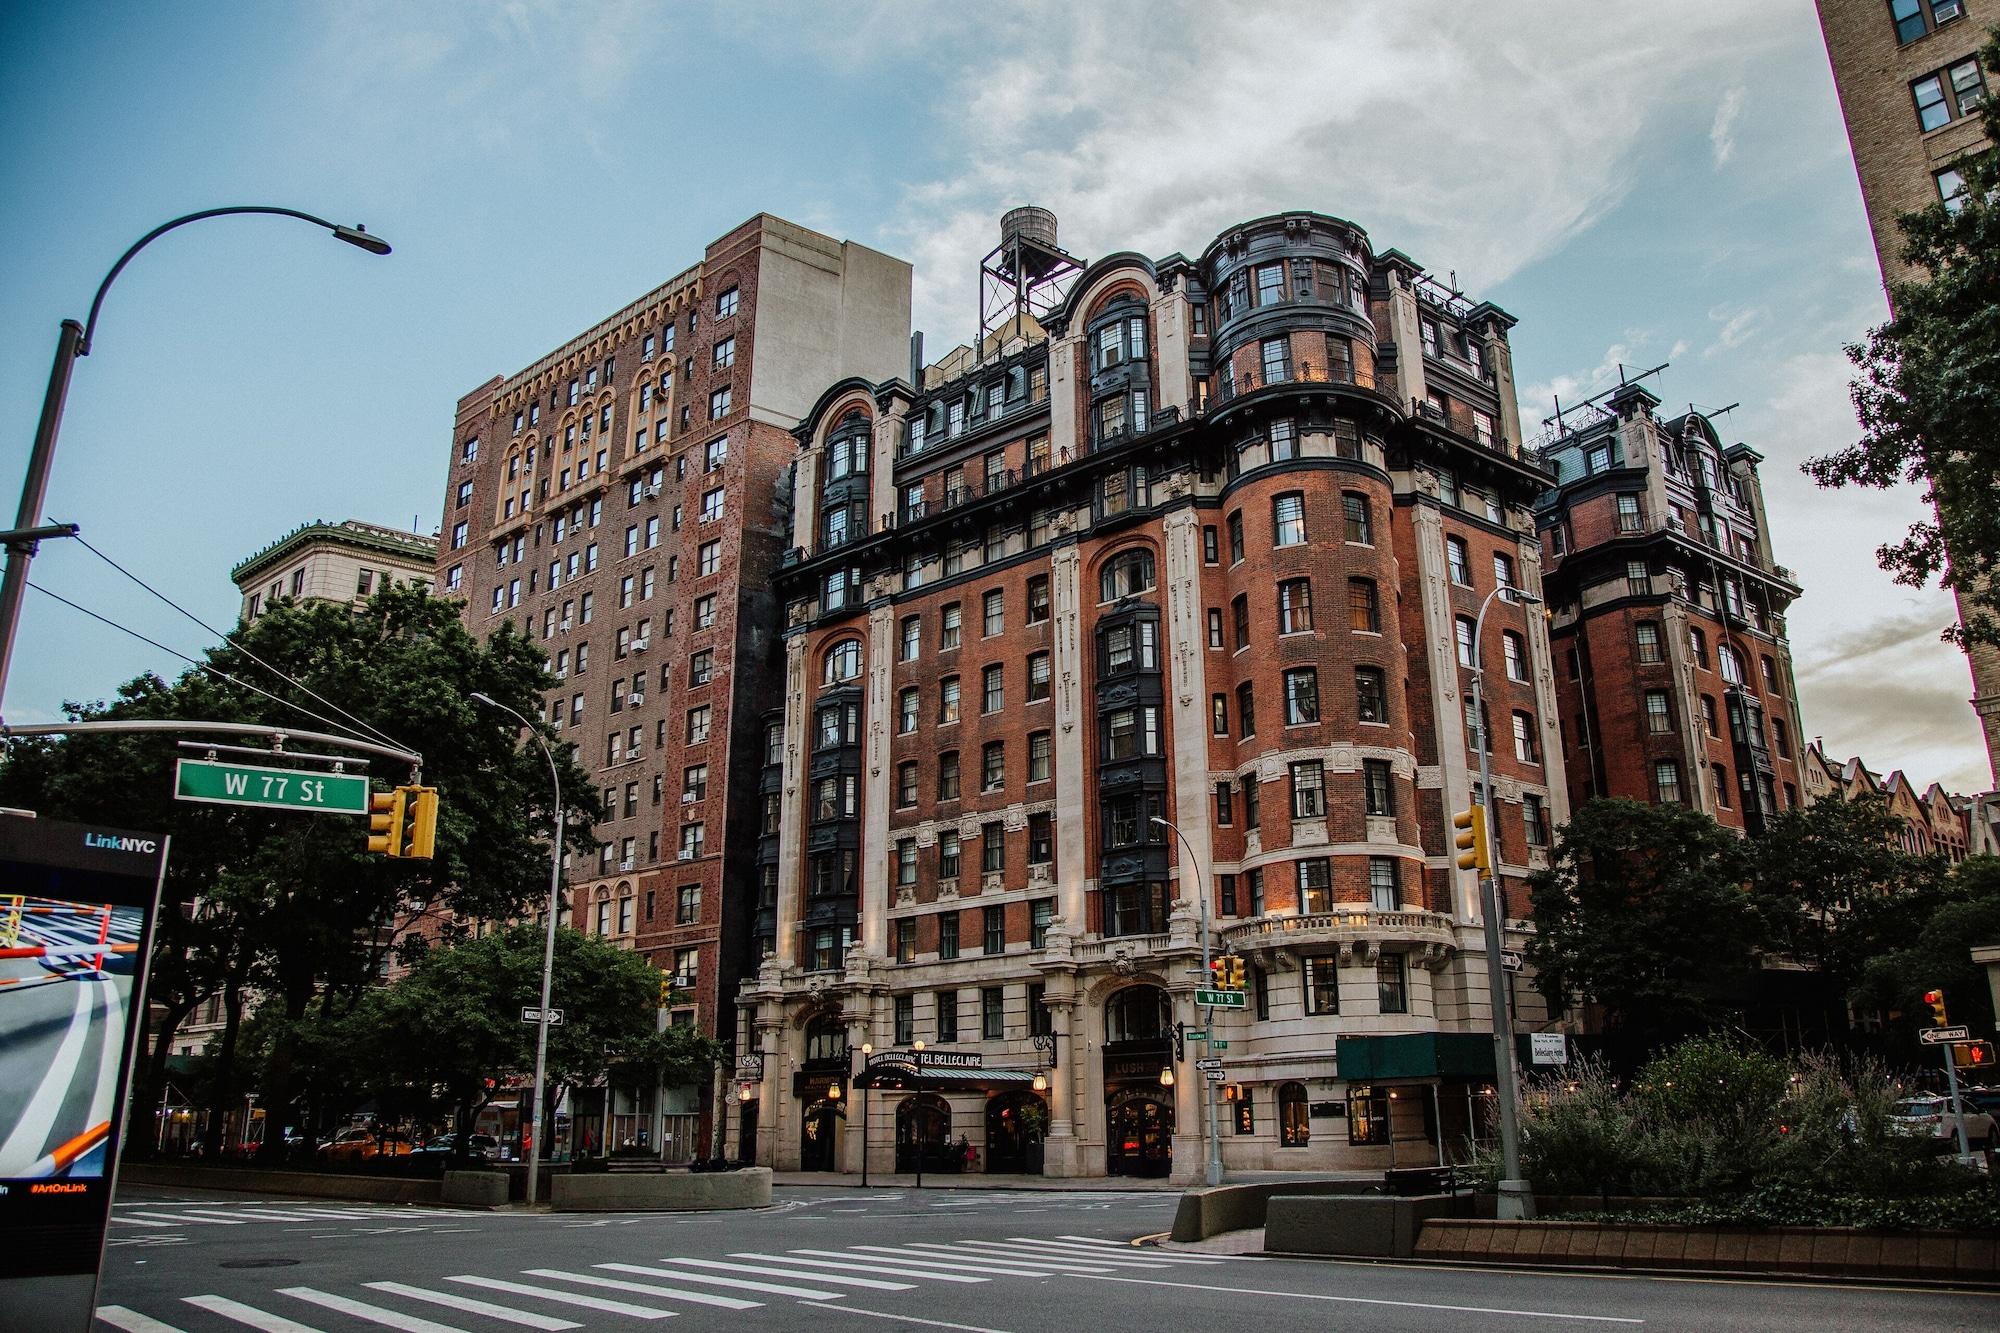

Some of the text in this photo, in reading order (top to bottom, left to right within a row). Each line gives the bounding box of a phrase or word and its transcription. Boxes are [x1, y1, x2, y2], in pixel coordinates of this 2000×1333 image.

[225, 773, 324, 802] W 77 St
[85, 832, 156, 854] LinkNYC
[1207, 993, 1234, 1004] W 77 St
[934, 1054, 982, 1067] BELLECLAIRE
[1115, 1062, 1144, 1074] LUSH
[30, 1183, 88, 1194] #ArtOnLink
